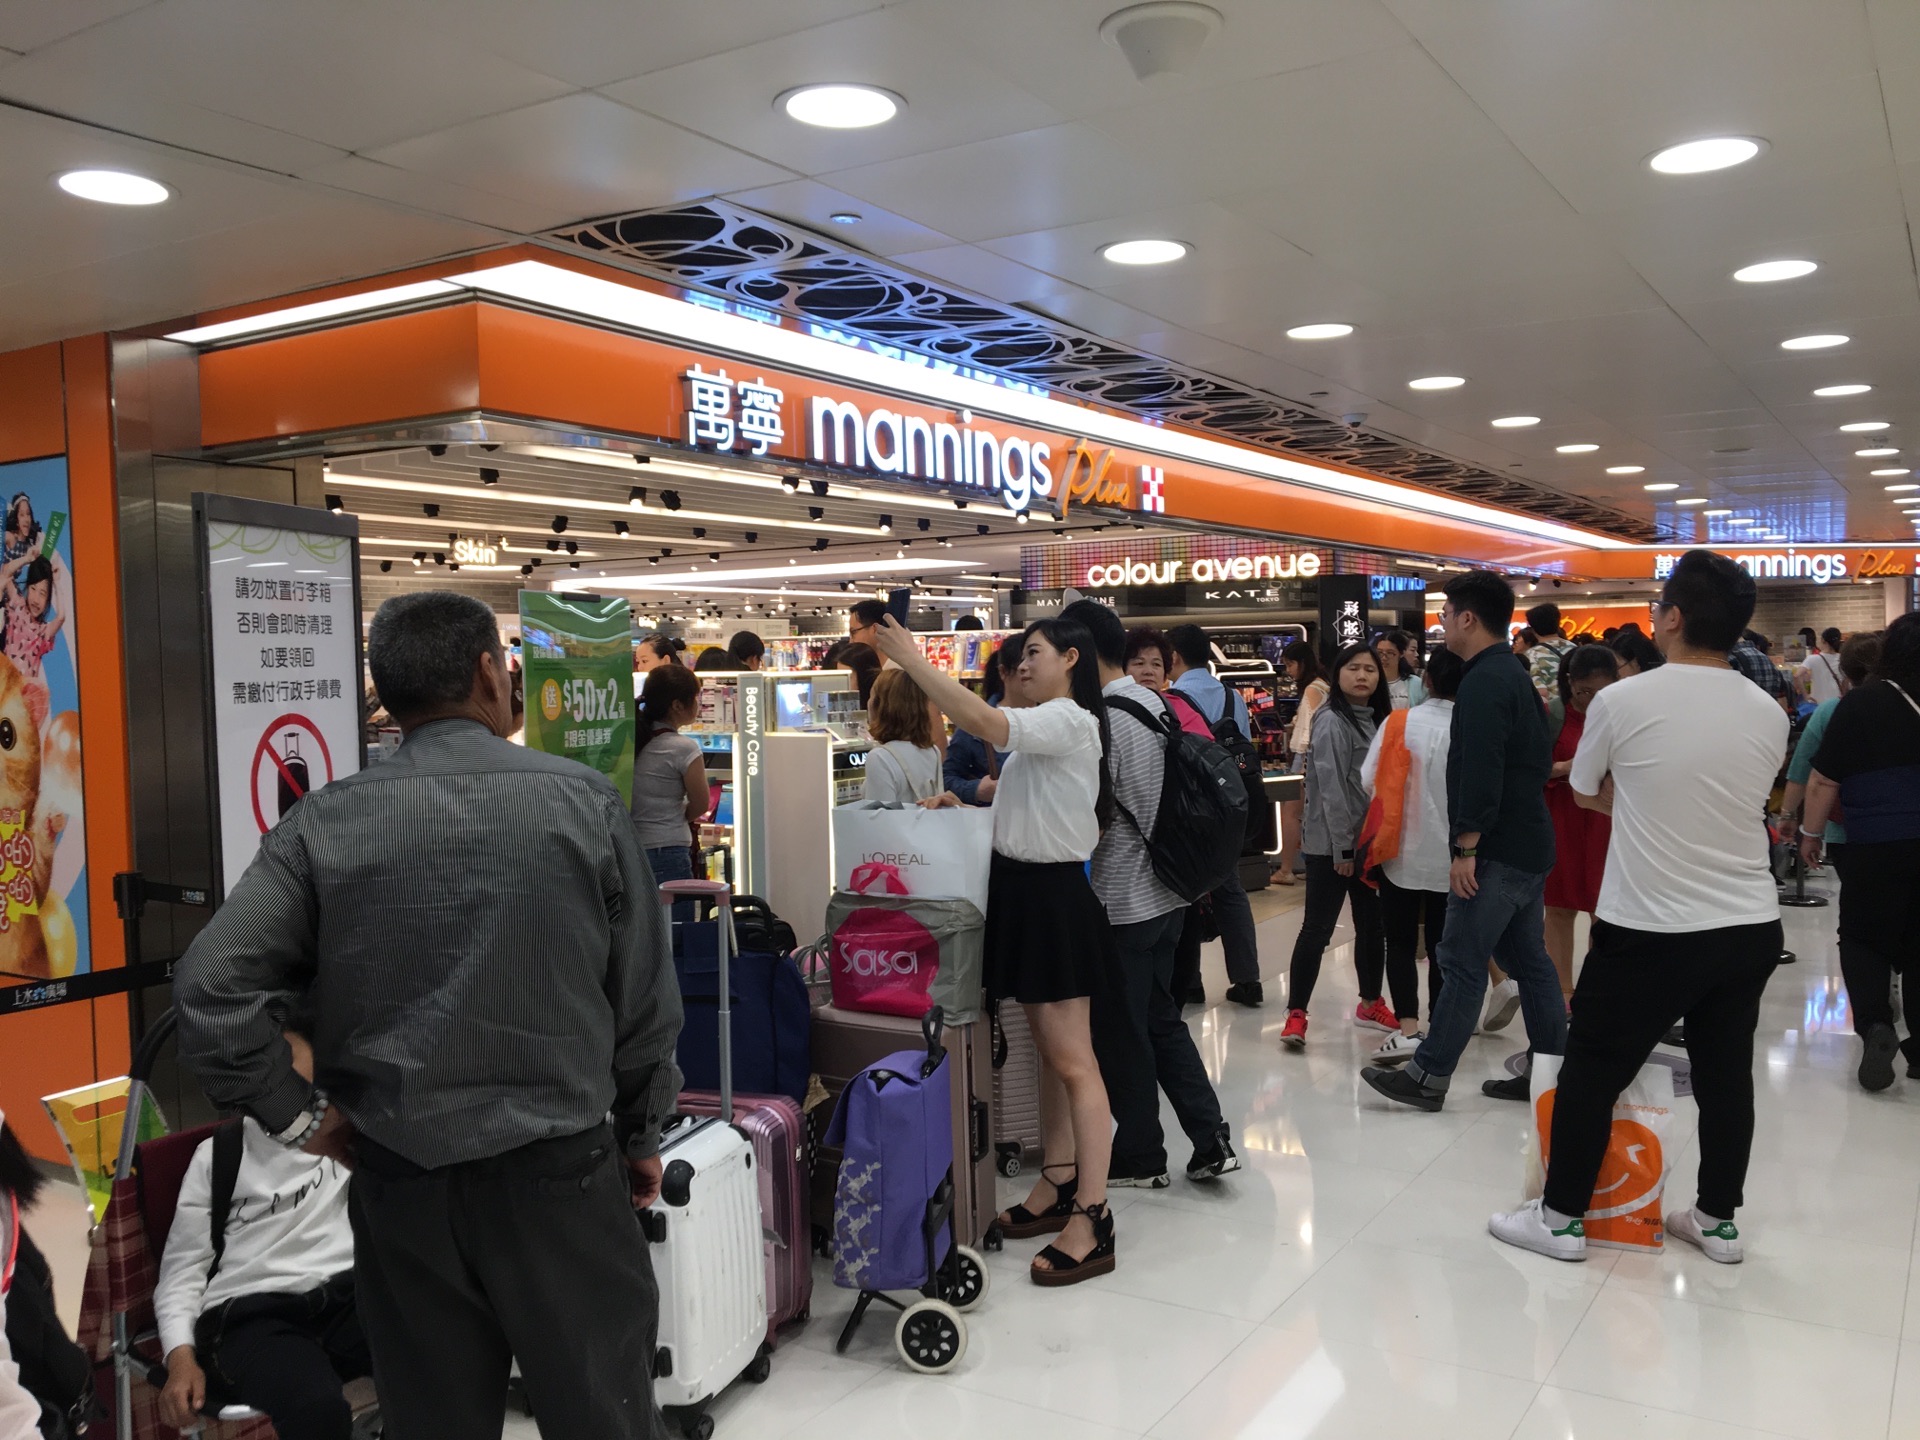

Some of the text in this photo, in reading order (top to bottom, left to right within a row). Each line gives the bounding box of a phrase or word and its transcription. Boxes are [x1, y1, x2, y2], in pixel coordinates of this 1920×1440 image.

[685, 363, 785, 456] 萬寧
[810, 395, 1132, 516] mannings Plus
[1087, 552, 1322, 588] colour avenue
[1730, 549, 1906, 584] annings Plus
[235, 577, 332, 603] 請勿放置行李箱
[1205, 589, 1280, 600] KATE
[237, 612, 333, 635] 否則會即時清理
[261, 647, 315, 668] 如要領回
[233, 679, 342, 704] 需繳付行政手續費
[745, 687, 760, 776] Beauty Care
[840, 942, 918, 976] Sasa
